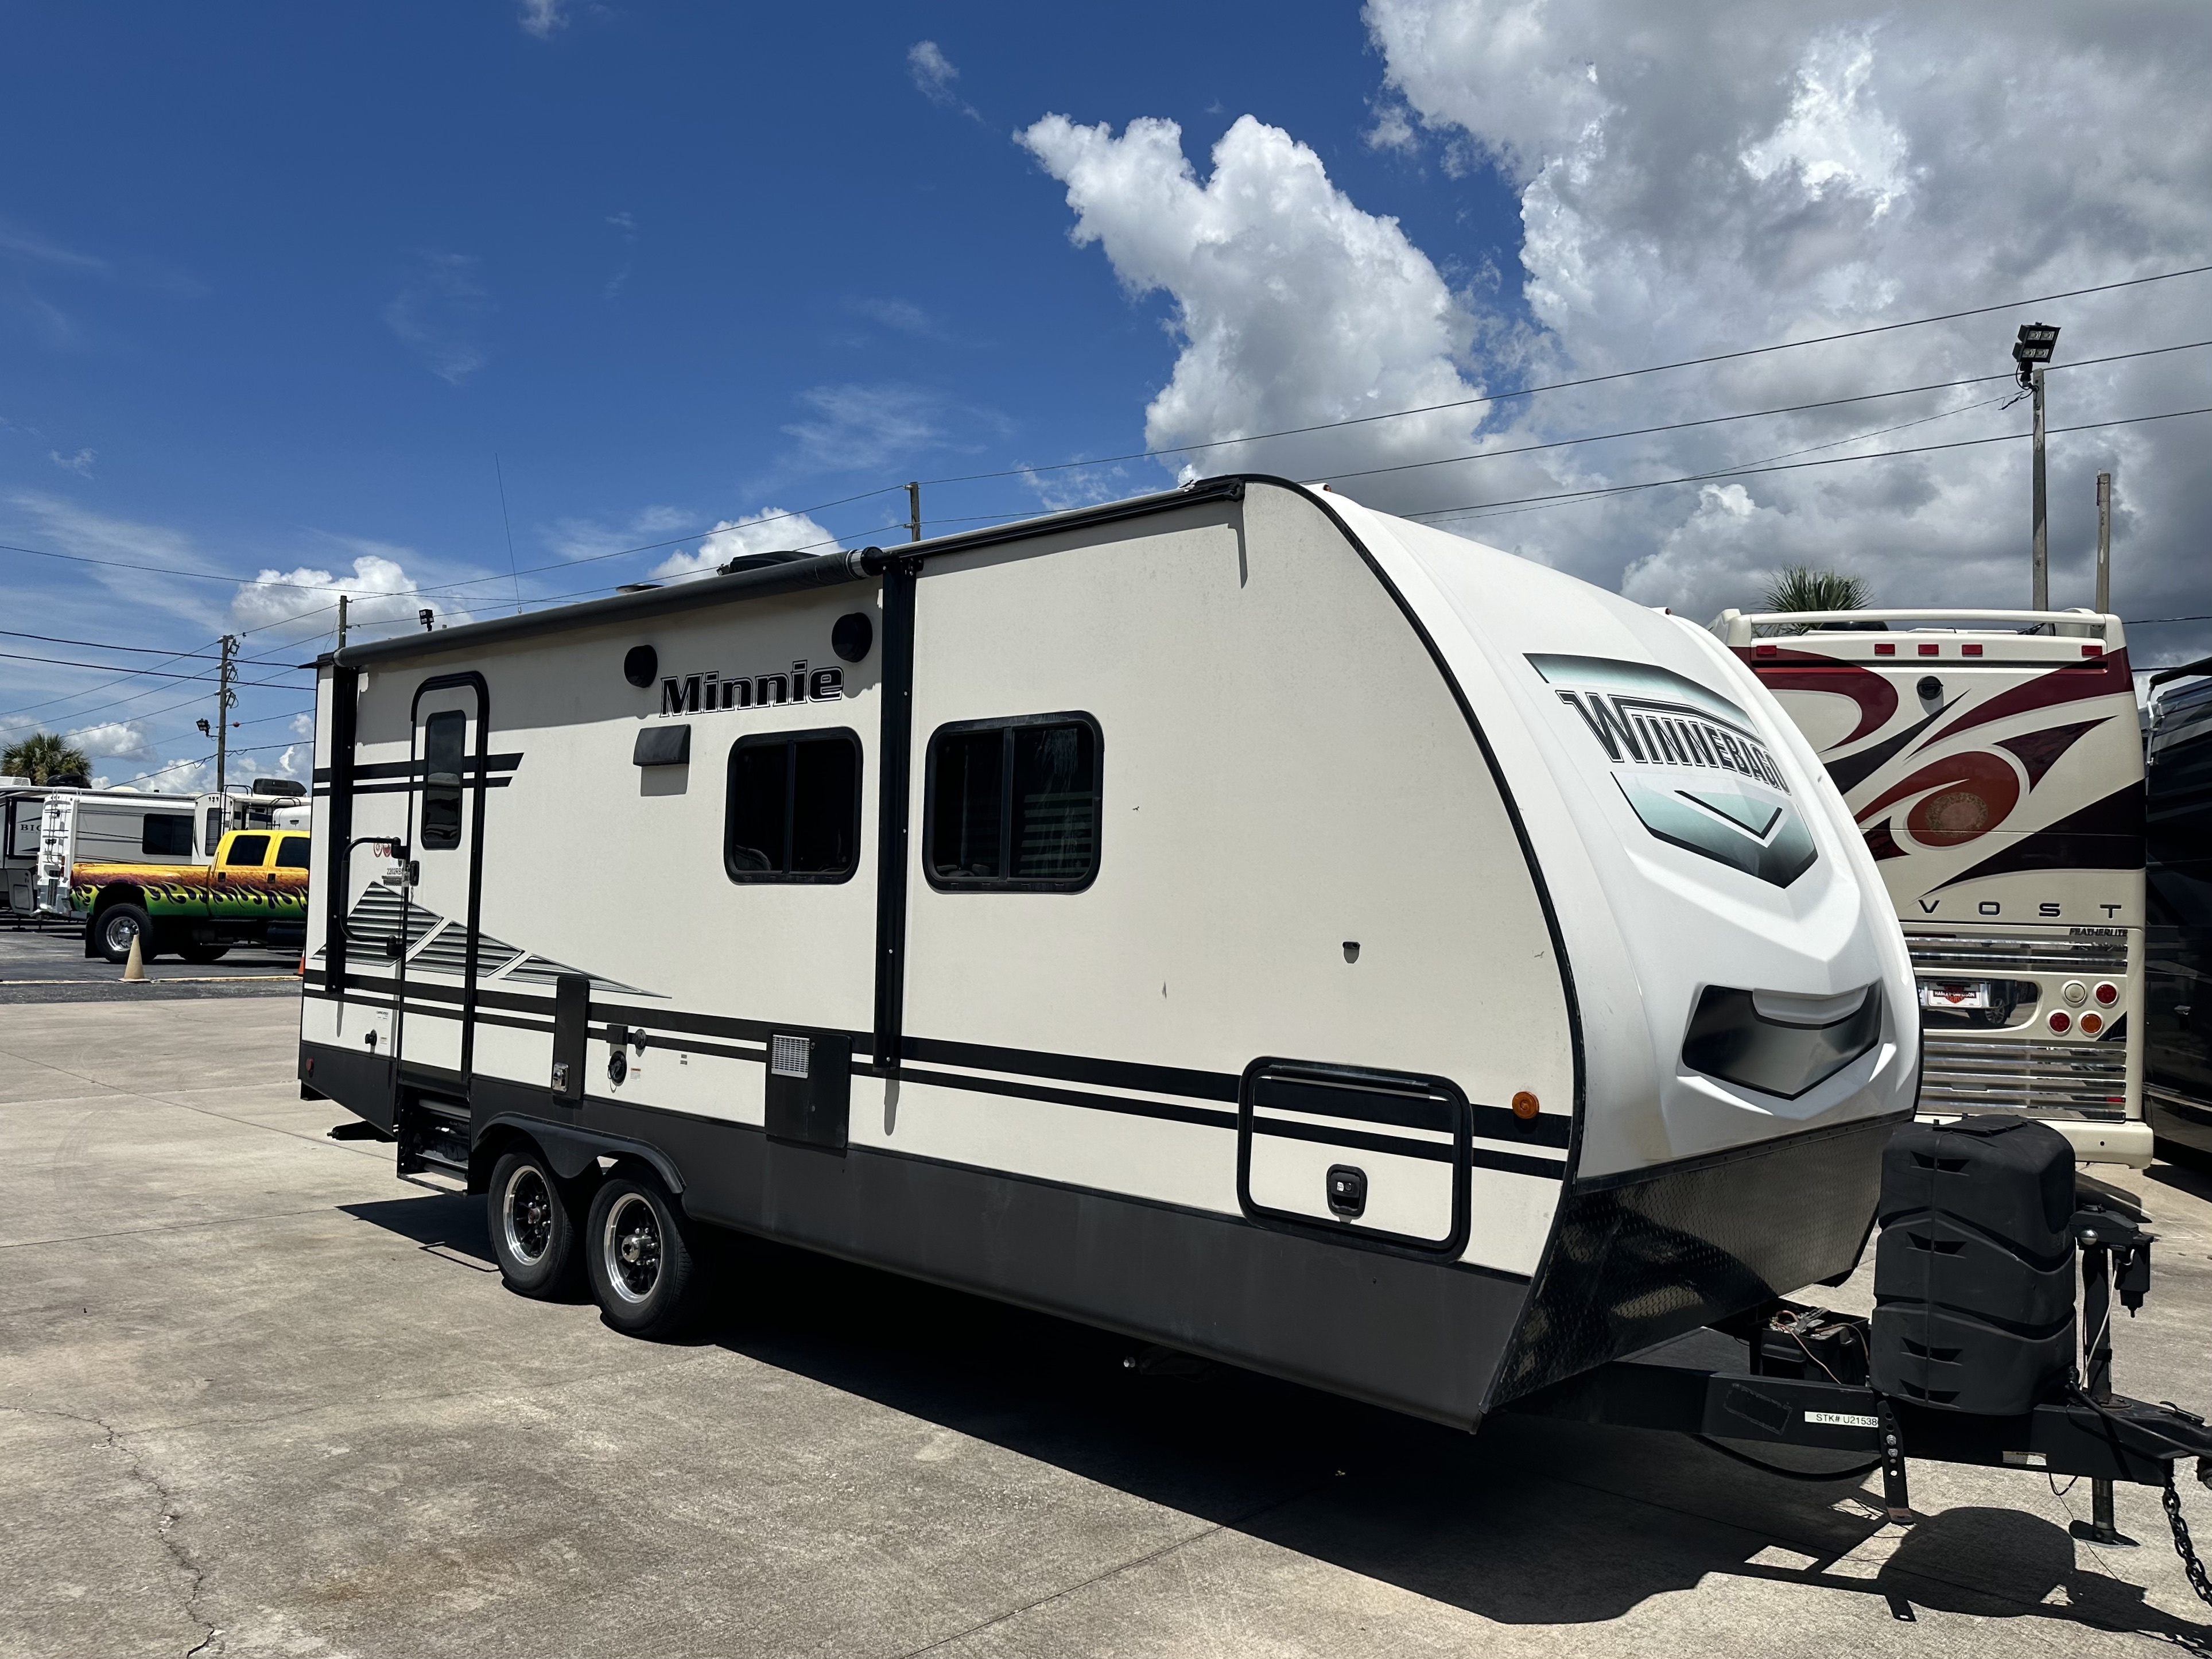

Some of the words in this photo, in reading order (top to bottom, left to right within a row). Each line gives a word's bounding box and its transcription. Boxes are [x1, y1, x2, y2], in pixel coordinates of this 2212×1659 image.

[659, 660, 844, 718] Minnie
[1555, 689, 1792, 796] WINNEBAGO
[2069, 928, 2128, 936] FEATHERLITE
[1816, 1413, 1840, 1422] STK#
[1843, 1416, 1877, 1426] U21538
